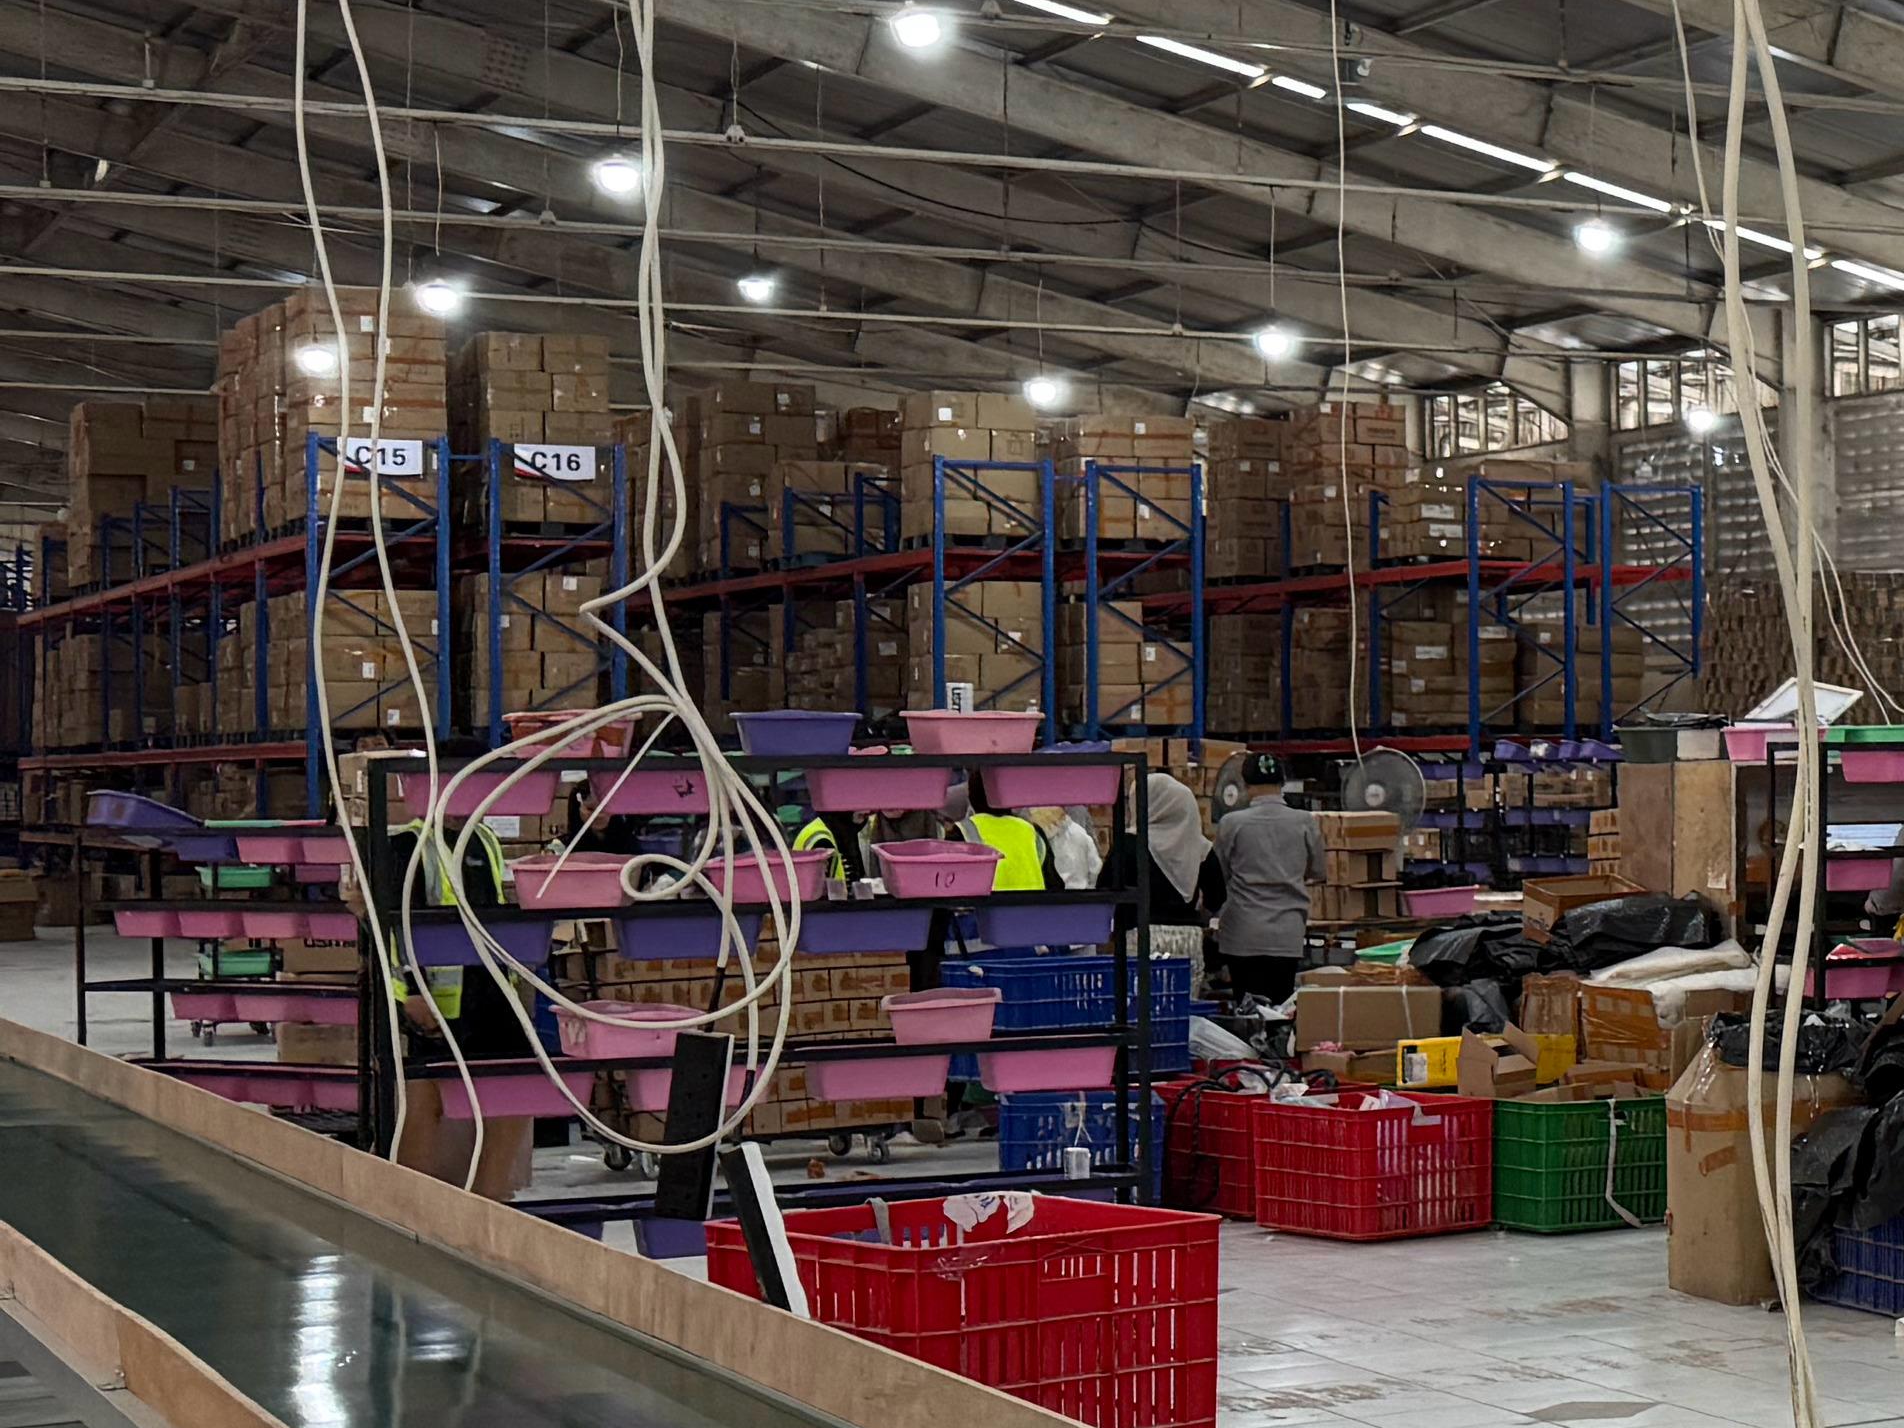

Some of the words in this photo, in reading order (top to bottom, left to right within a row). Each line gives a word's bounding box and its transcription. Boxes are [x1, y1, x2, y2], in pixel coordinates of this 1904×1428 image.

[355, 445, 406, 466] C15
[531, 451, 581, 472] C16
[935, 871, 955, 888] 10
